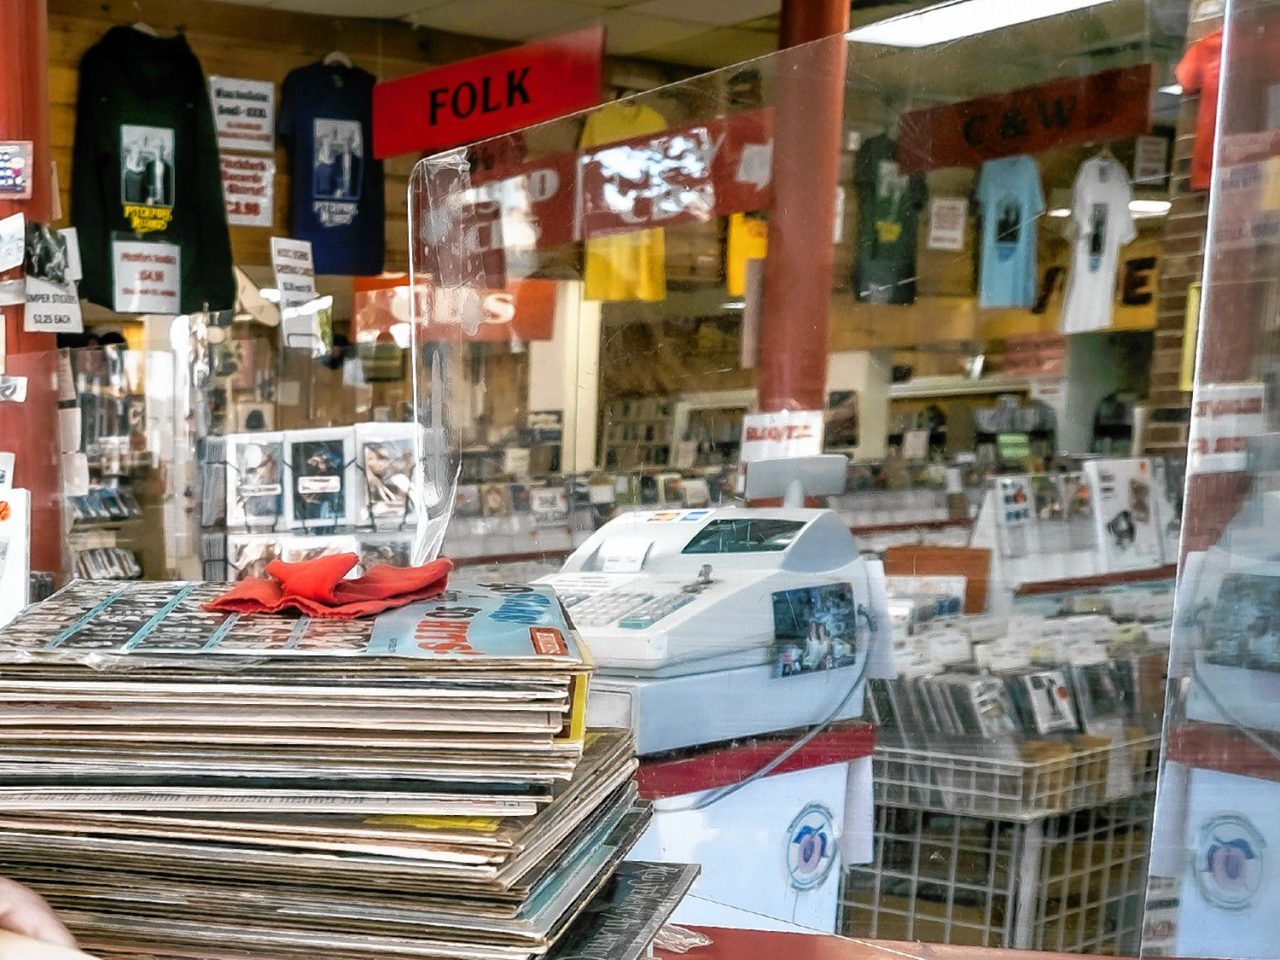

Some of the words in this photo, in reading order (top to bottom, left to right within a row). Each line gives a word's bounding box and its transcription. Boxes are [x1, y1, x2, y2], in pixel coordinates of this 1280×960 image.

[428, 66, 531, 126] FOLK
[963, 114, 990, 146] C
[1037, 96, 1077, 129] W
[27, 293, 51, 305] UMPER
